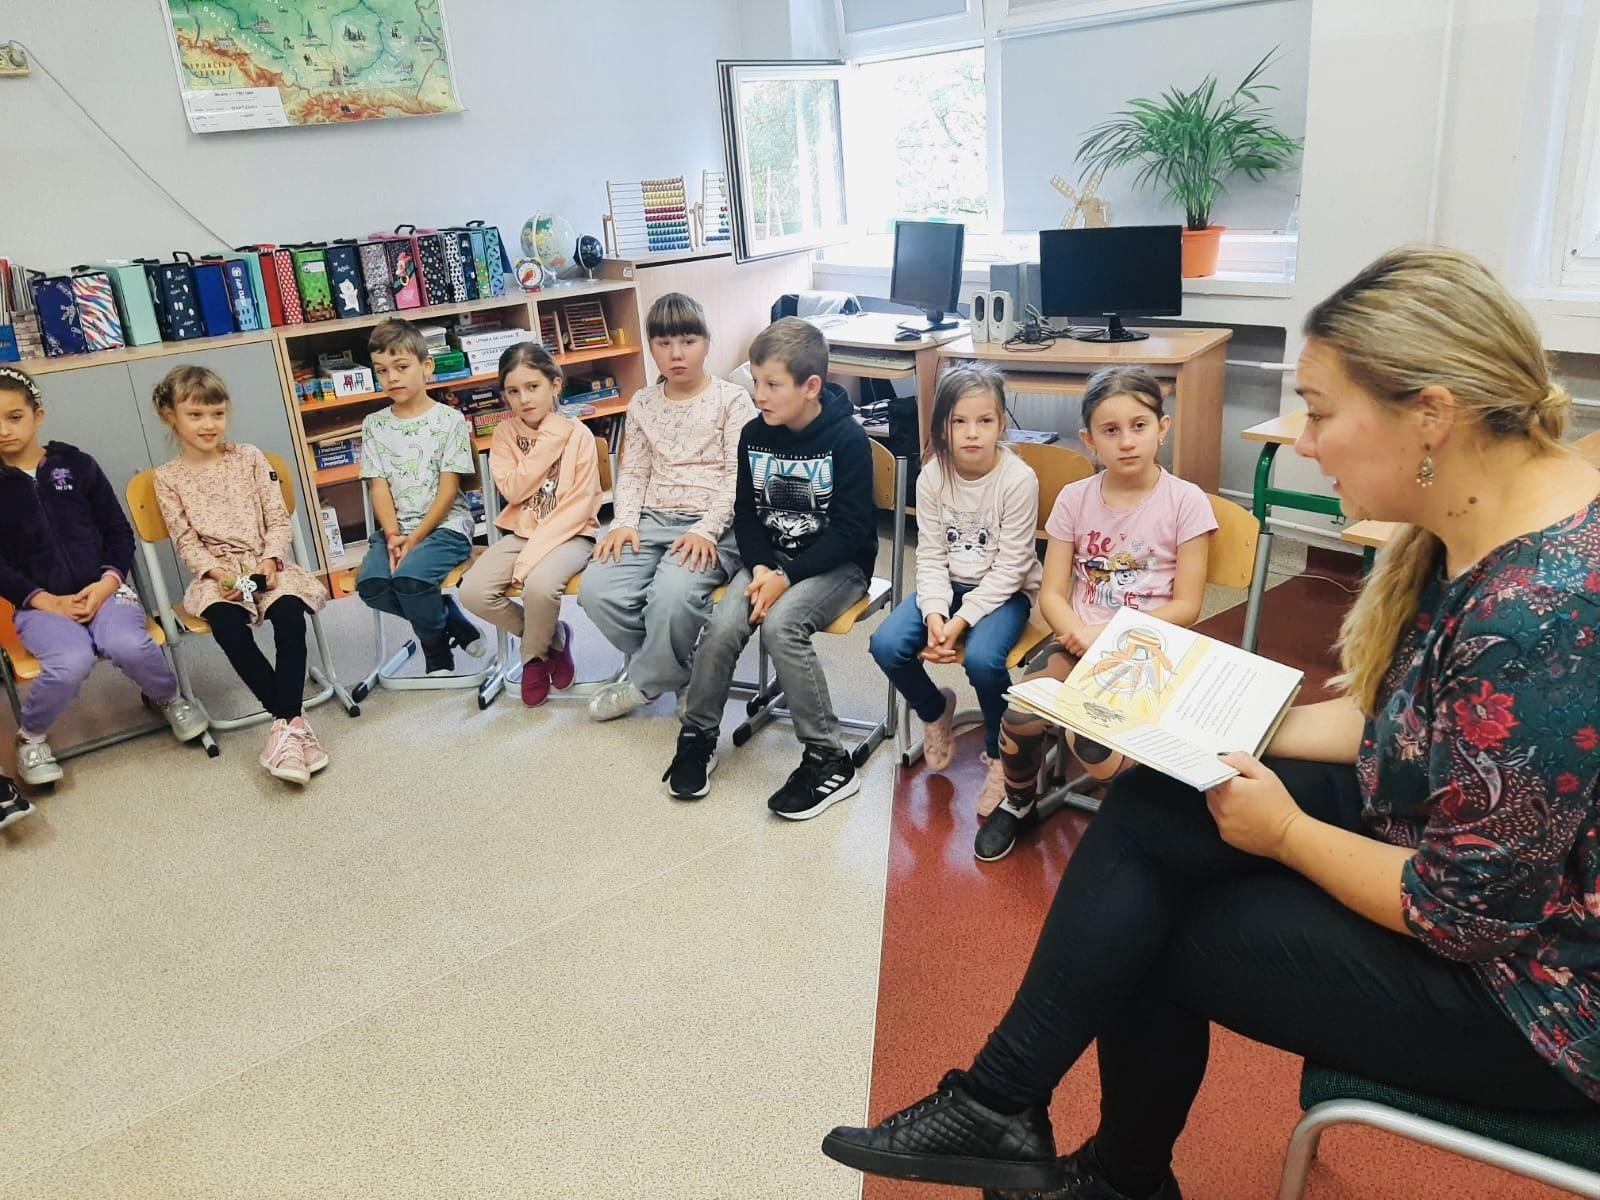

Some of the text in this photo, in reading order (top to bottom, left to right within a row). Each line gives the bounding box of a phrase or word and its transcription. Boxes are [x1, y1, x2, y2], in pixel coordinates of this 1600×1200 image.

[748, 452, 833, 488] TOKYO
[1086, 530, 1116, 556] Be
[1082, 580, 1139, 610] NICE
